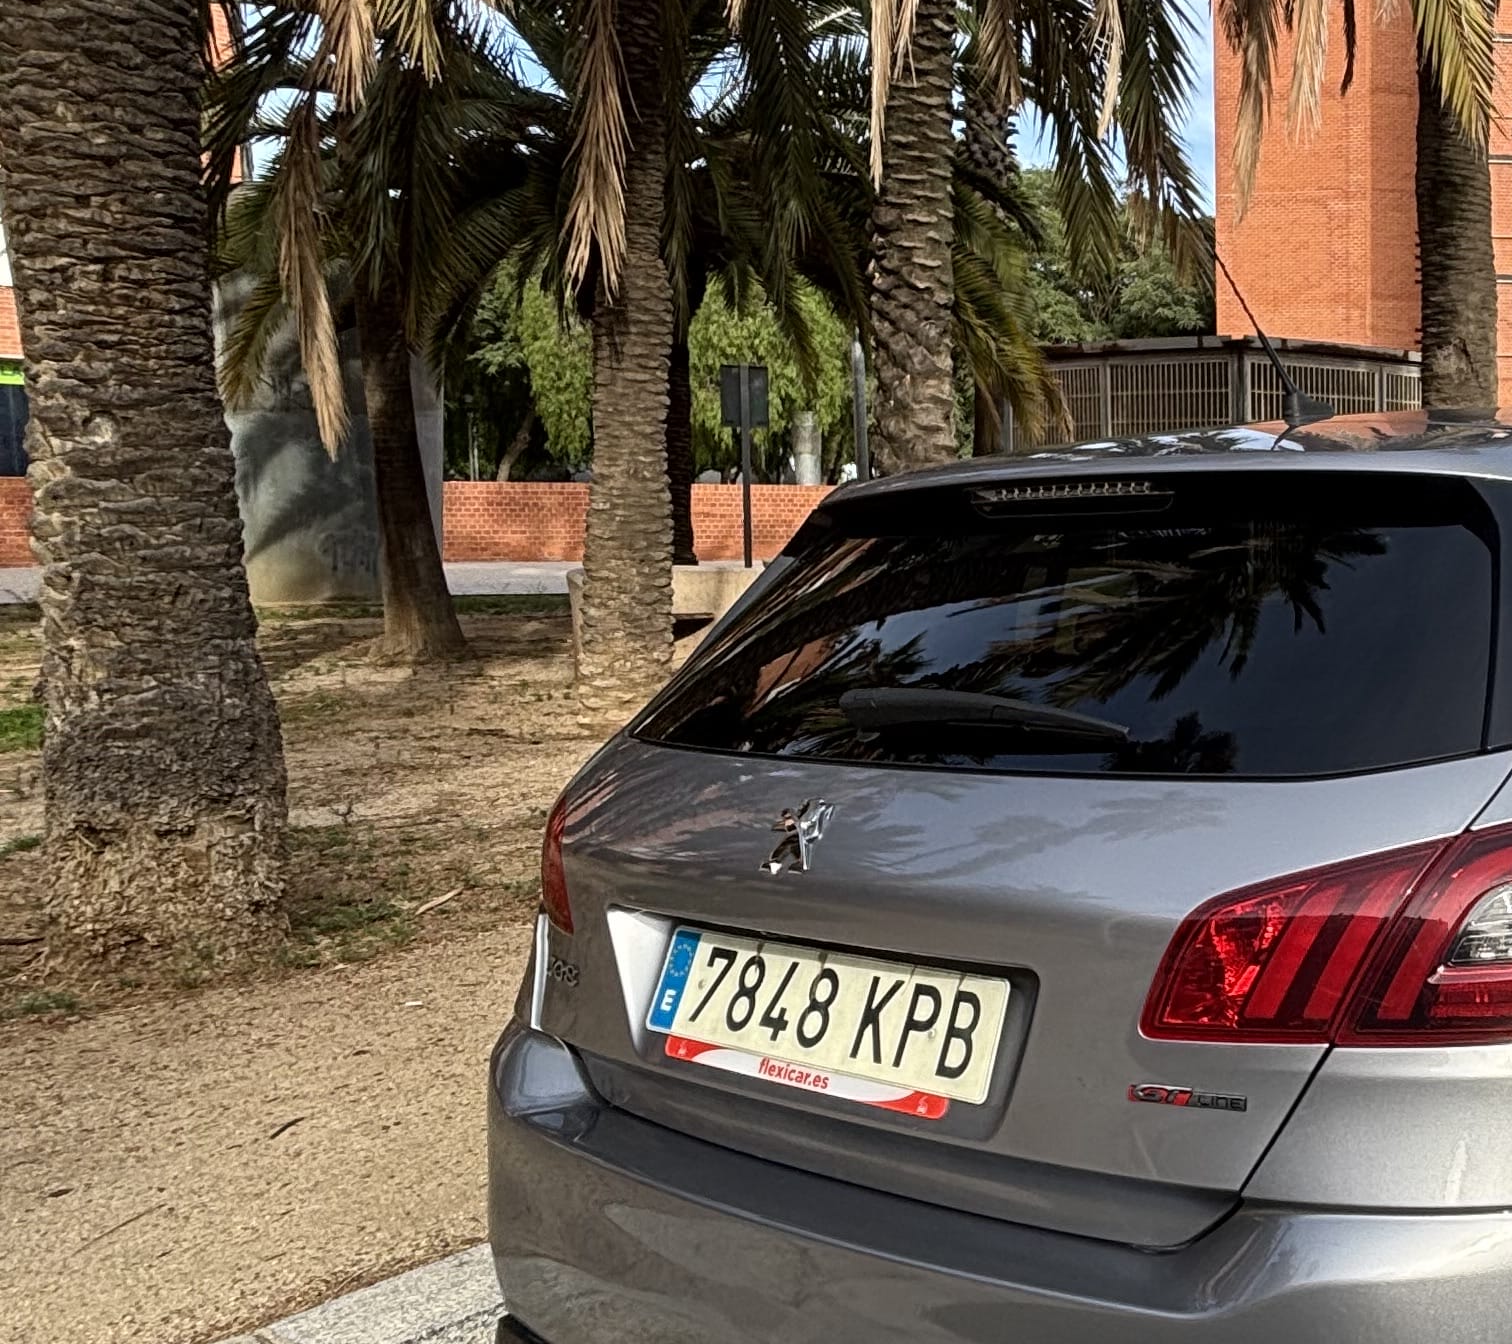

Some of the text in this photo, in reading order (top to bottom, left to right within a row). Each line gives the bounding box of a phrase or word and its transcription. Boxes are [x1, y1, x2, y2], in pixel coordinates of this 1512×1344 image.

[660, 989, 677, 1013] E
[688, 946, 982, 1080] 7848 KPB
[758, 1055, 830, 1090] flexicar.es
